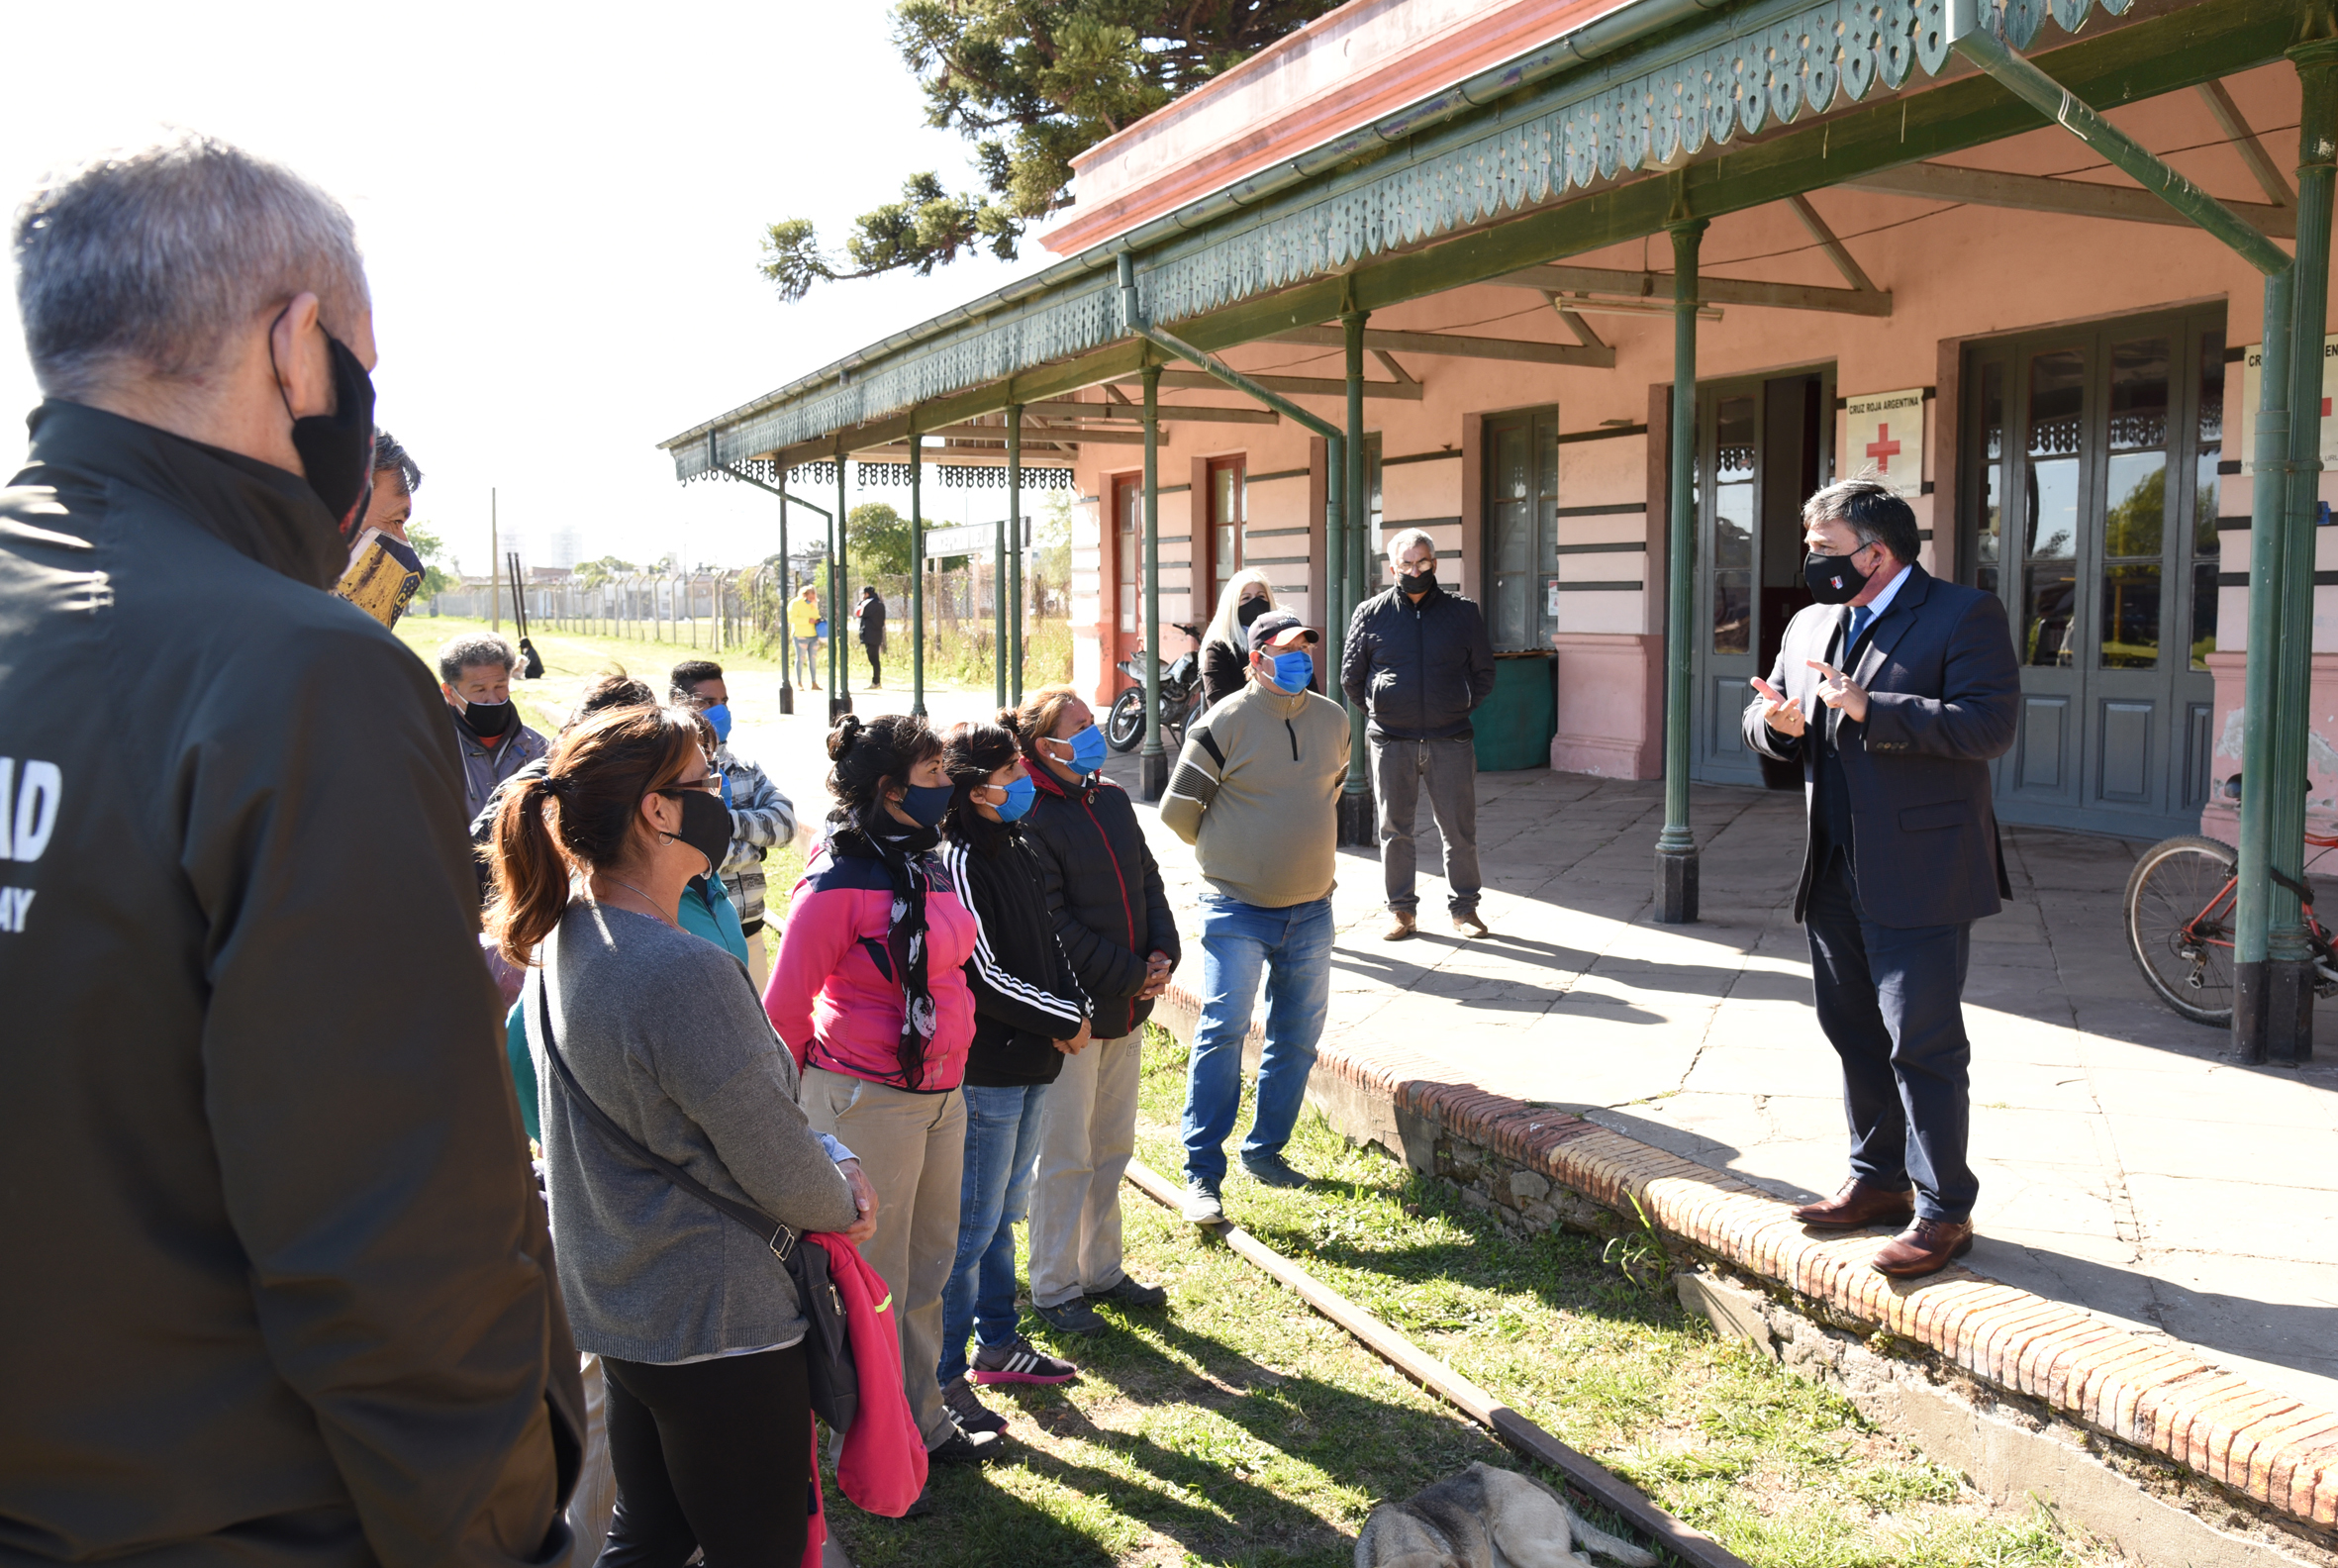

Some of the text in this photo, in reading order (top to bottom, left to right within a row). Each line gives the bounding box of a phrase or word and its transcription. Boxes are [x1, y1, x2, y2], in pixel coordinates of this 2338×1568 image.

[1849, 396, 1919, 415] CRUZ ROJA ARGENTINA
